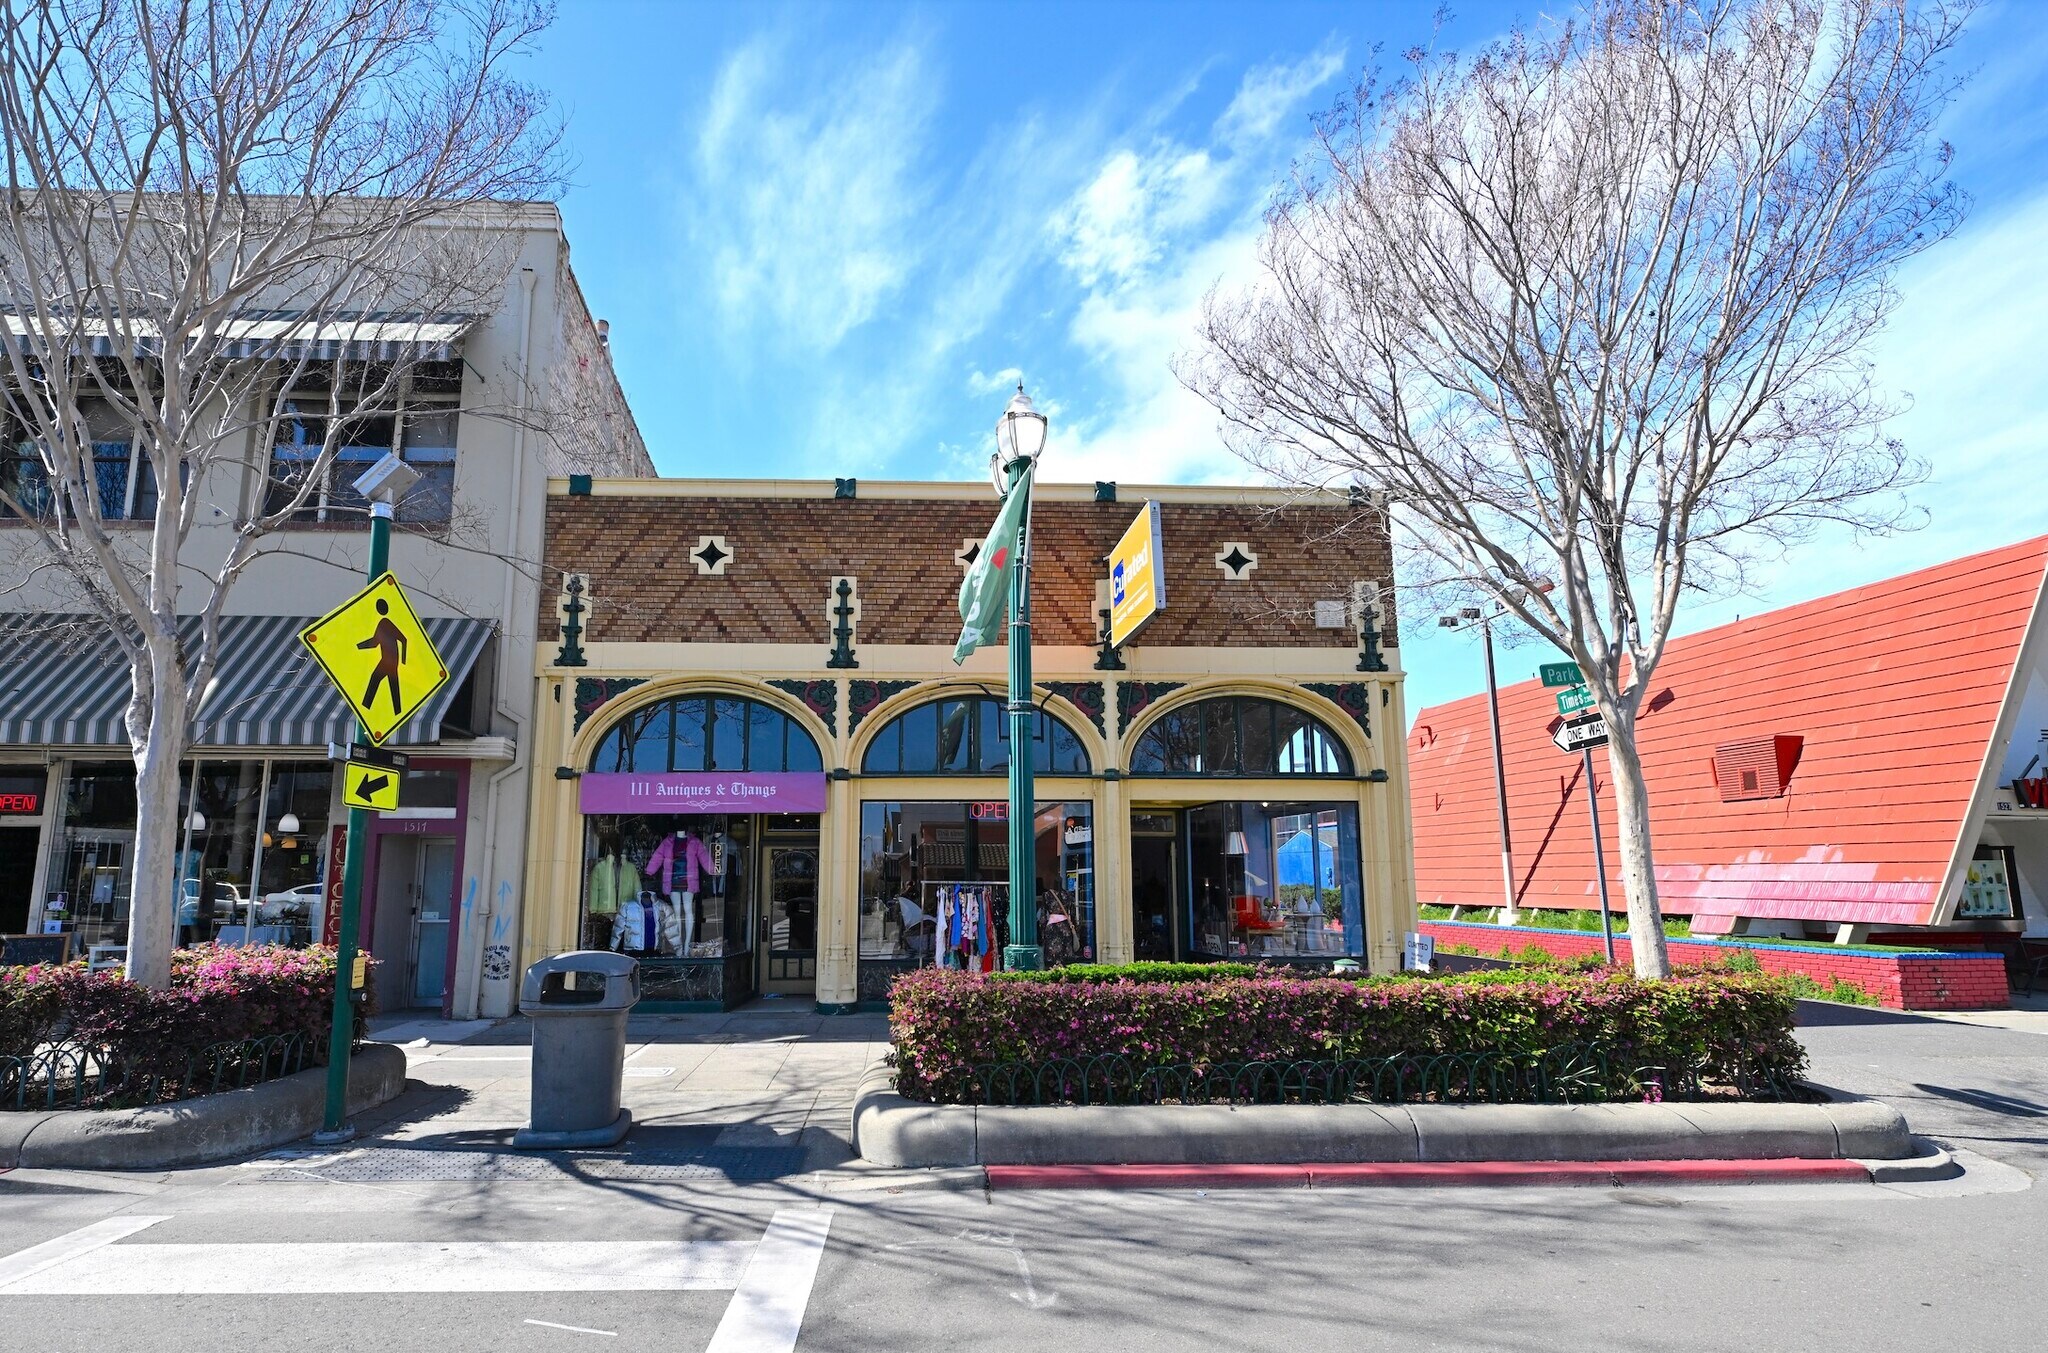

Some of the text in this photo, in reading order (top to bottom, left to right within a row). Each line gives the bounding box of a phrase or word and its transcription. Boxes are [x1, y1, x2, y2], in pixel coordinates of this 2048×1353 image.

[1113, 540, 1148, 599] Curated
[1547, 667, 1576, 683] Park
[1560, 693, 1584, 710] Times
[1566, 722, 1606, 742] ONE WAY
[655, 782, 711, 799] Antiques
[716, 783, 726, 796] &
[731, 781, 777, 799] Thangs
[0, 796, 34, 810] PEN
[714, 843, 722, 874] OPEN
